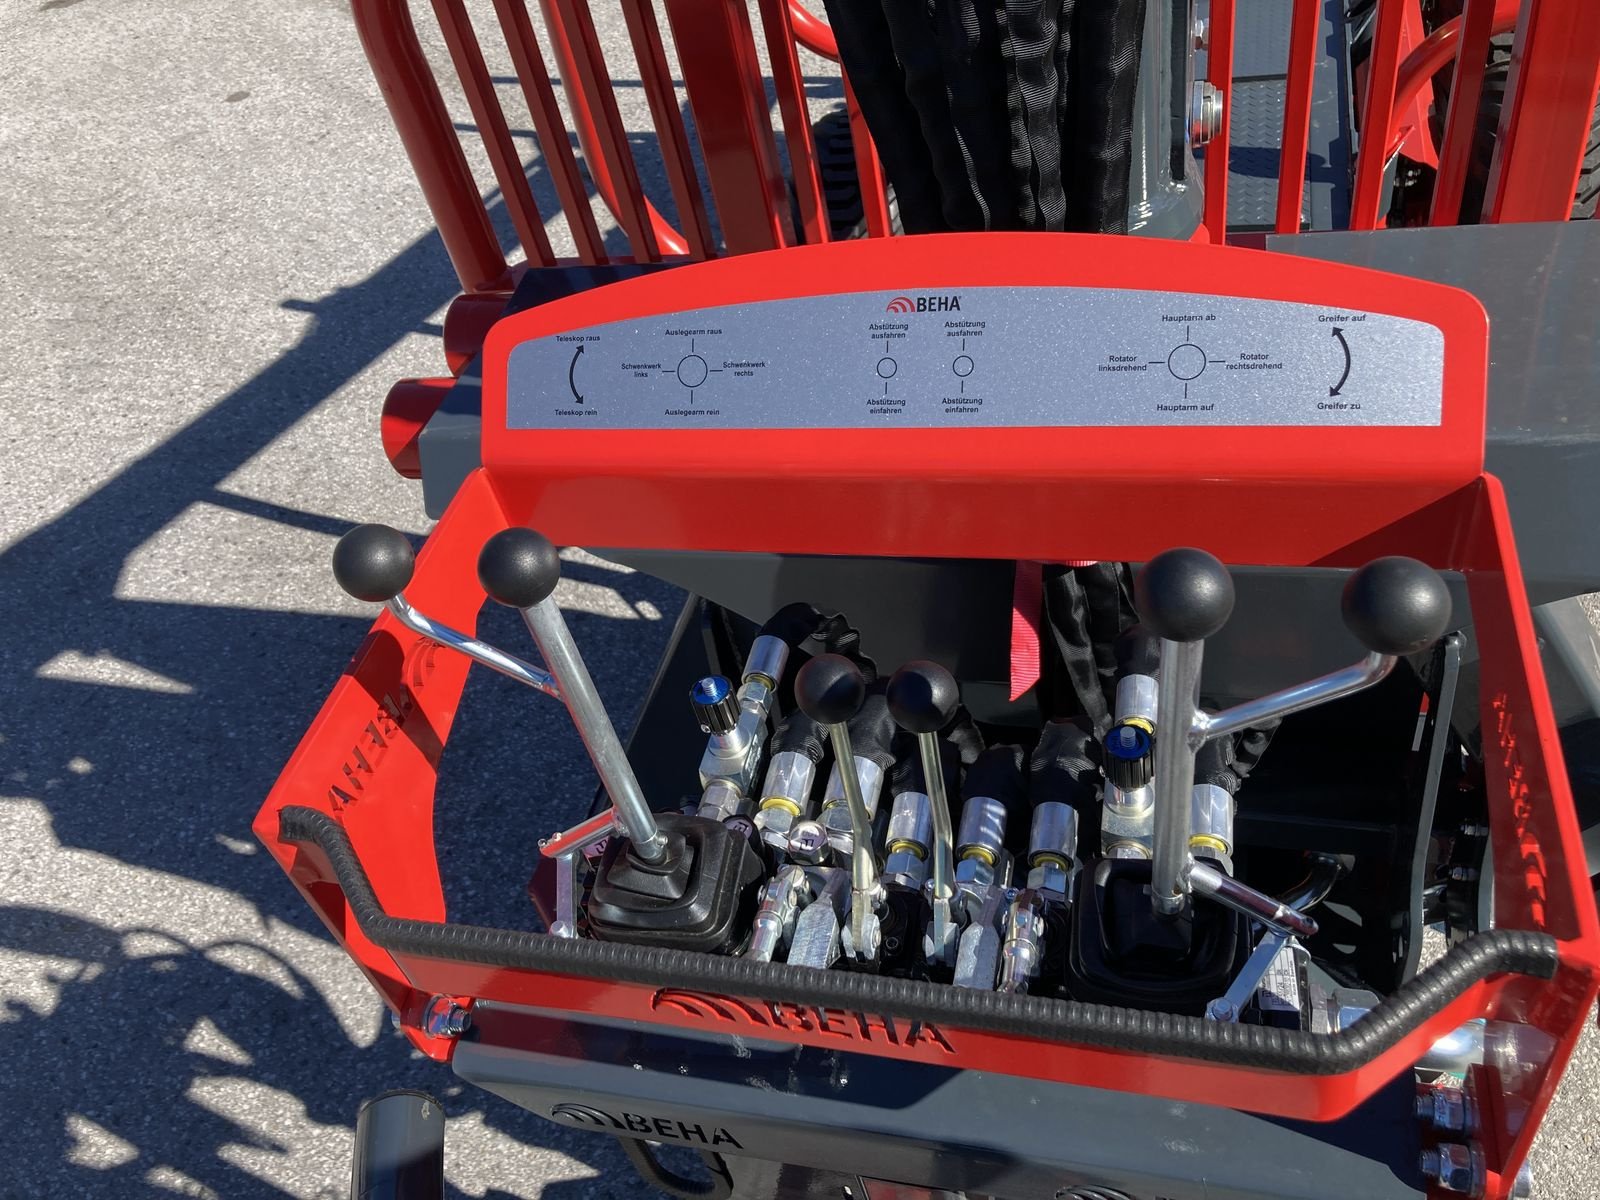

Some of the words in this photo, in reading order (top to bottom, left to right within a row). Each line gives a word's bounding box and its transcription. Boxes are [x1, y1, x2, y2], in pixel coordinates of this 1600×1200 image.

[917, 296, 961, 312] BEHA
[1161, 314, 1203, 322] Hauptarm
[1318, 314, 1349, 322] Greifer
[1351, 314, 1366, 322] auf
[868, 323, 909, 331] Abstützung
[723, 361, 766, 369] Schwenkwerk
[1226, 362, 1283, 370] rechtsdrehend
[866, 398, 906, 406] Abstützung
[942, 397, 983, 405] Abstützung
[1156, 403, 1198, 412] Hauptarm
[1200, 403, 1214, 411] auf
[1317, 402, 1348, 410] Greifer
[763, 999, 957, 1054] BEHA
[621, 1111, 744, 1149] BEHA
